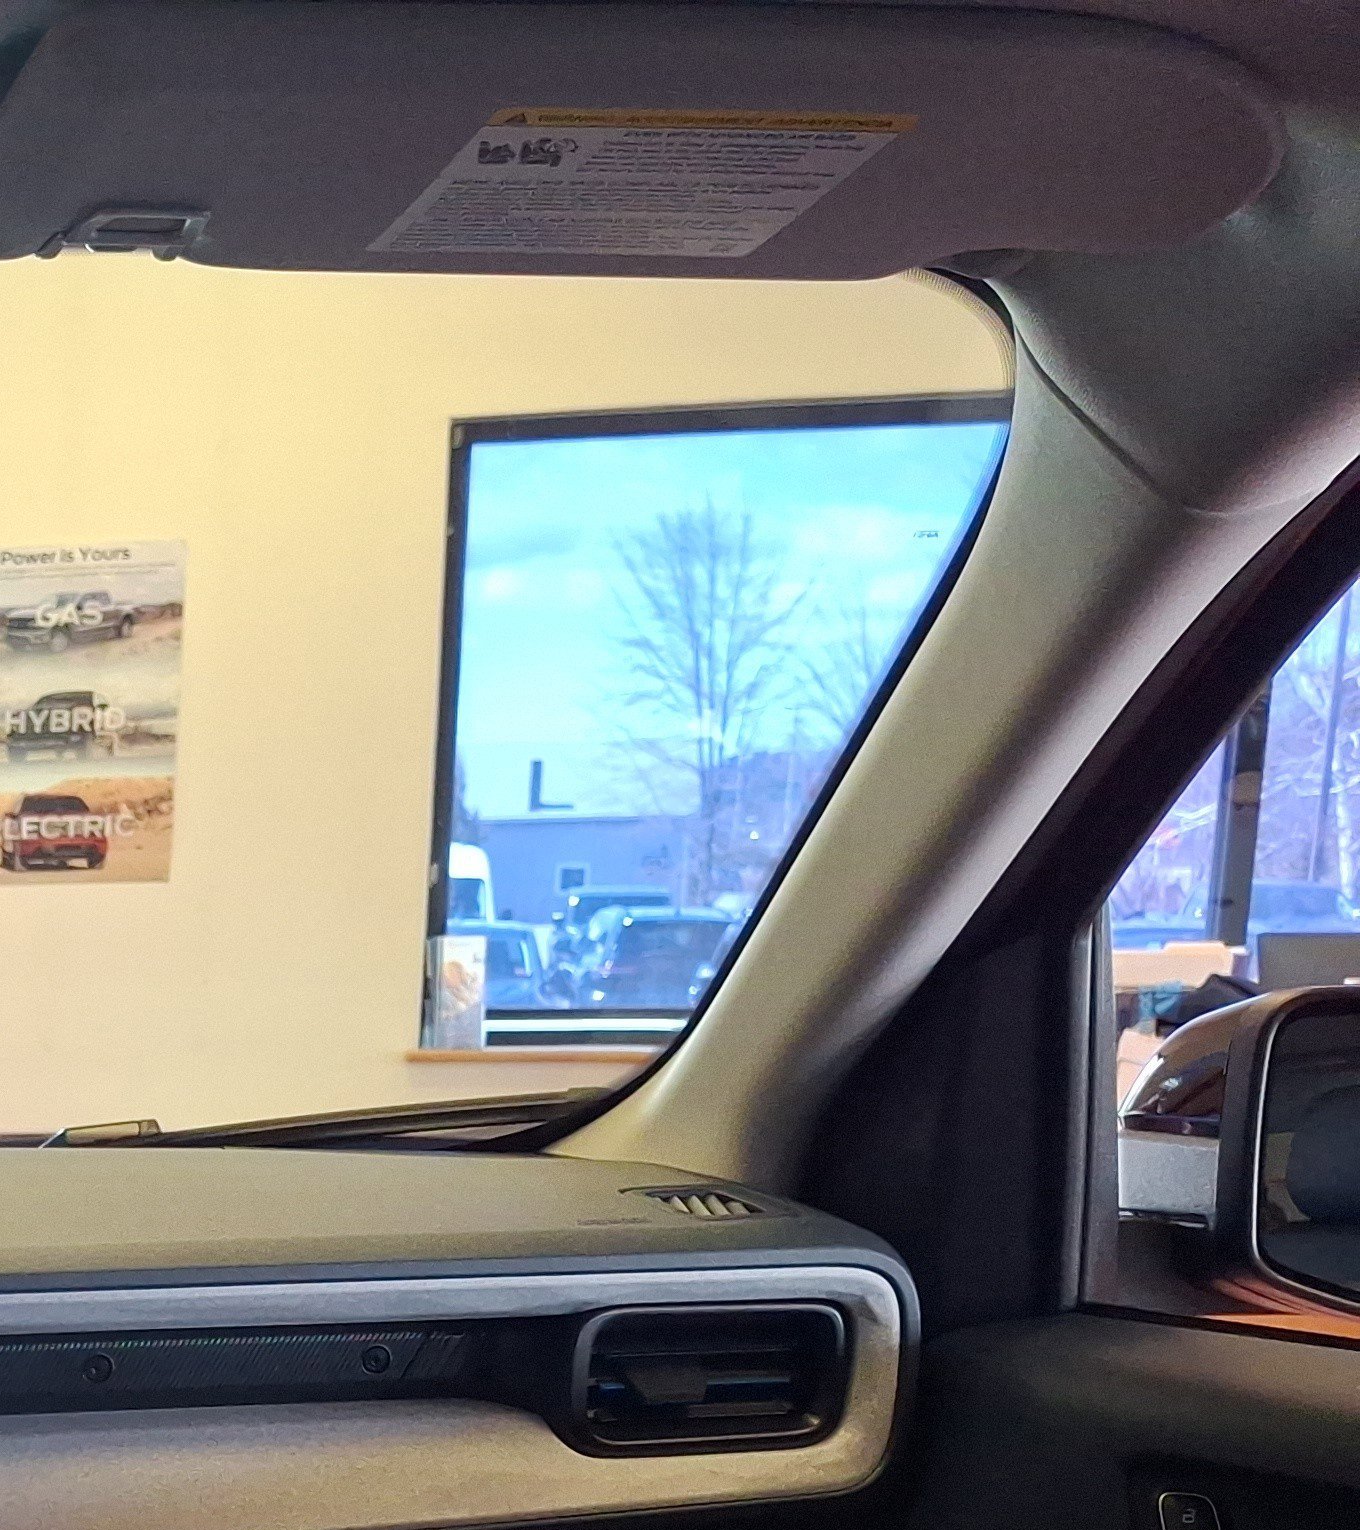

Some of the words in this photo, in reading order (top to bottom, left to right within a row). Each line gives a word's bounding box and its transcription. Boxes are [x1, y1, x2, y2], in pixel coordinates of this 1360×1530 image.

[0, 550, 56, 566] Power
[78, 548, 132, 562] Yours
[33, 602, 104, 628] GAS
[5, 705, 126, 735] HYBRID
